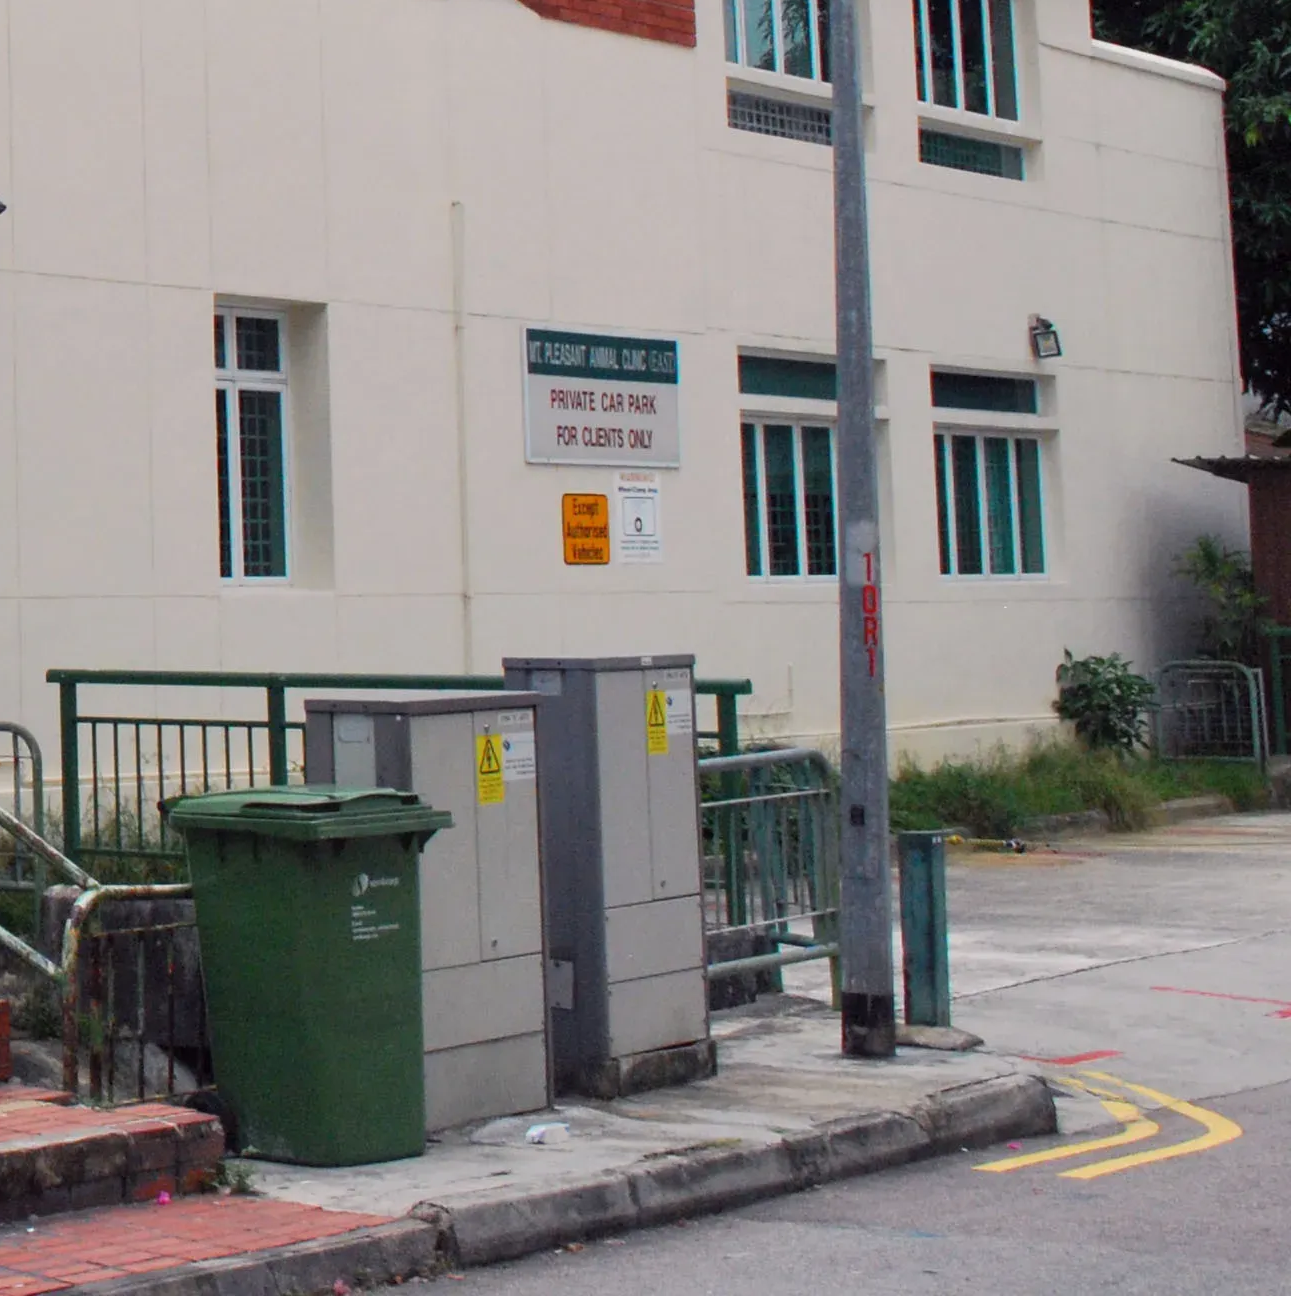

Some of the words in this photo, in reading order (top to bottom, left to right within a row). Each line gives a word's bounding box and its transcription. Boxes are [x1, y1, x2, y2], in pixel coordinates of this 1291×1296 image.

[544, 341, 587, 368] PLEASANT
[589, 344, 619, 370] ANIMAL
[550, 388, 596, 412] PRIVATE
[601, 391, 625, 413] CAR
[628, 394, 657, 415] PARK
[556, 424, 578, 447] FOR
[581, 425, 625, 449] CLIENTS
[628, 428, 653, 450] ONLY
